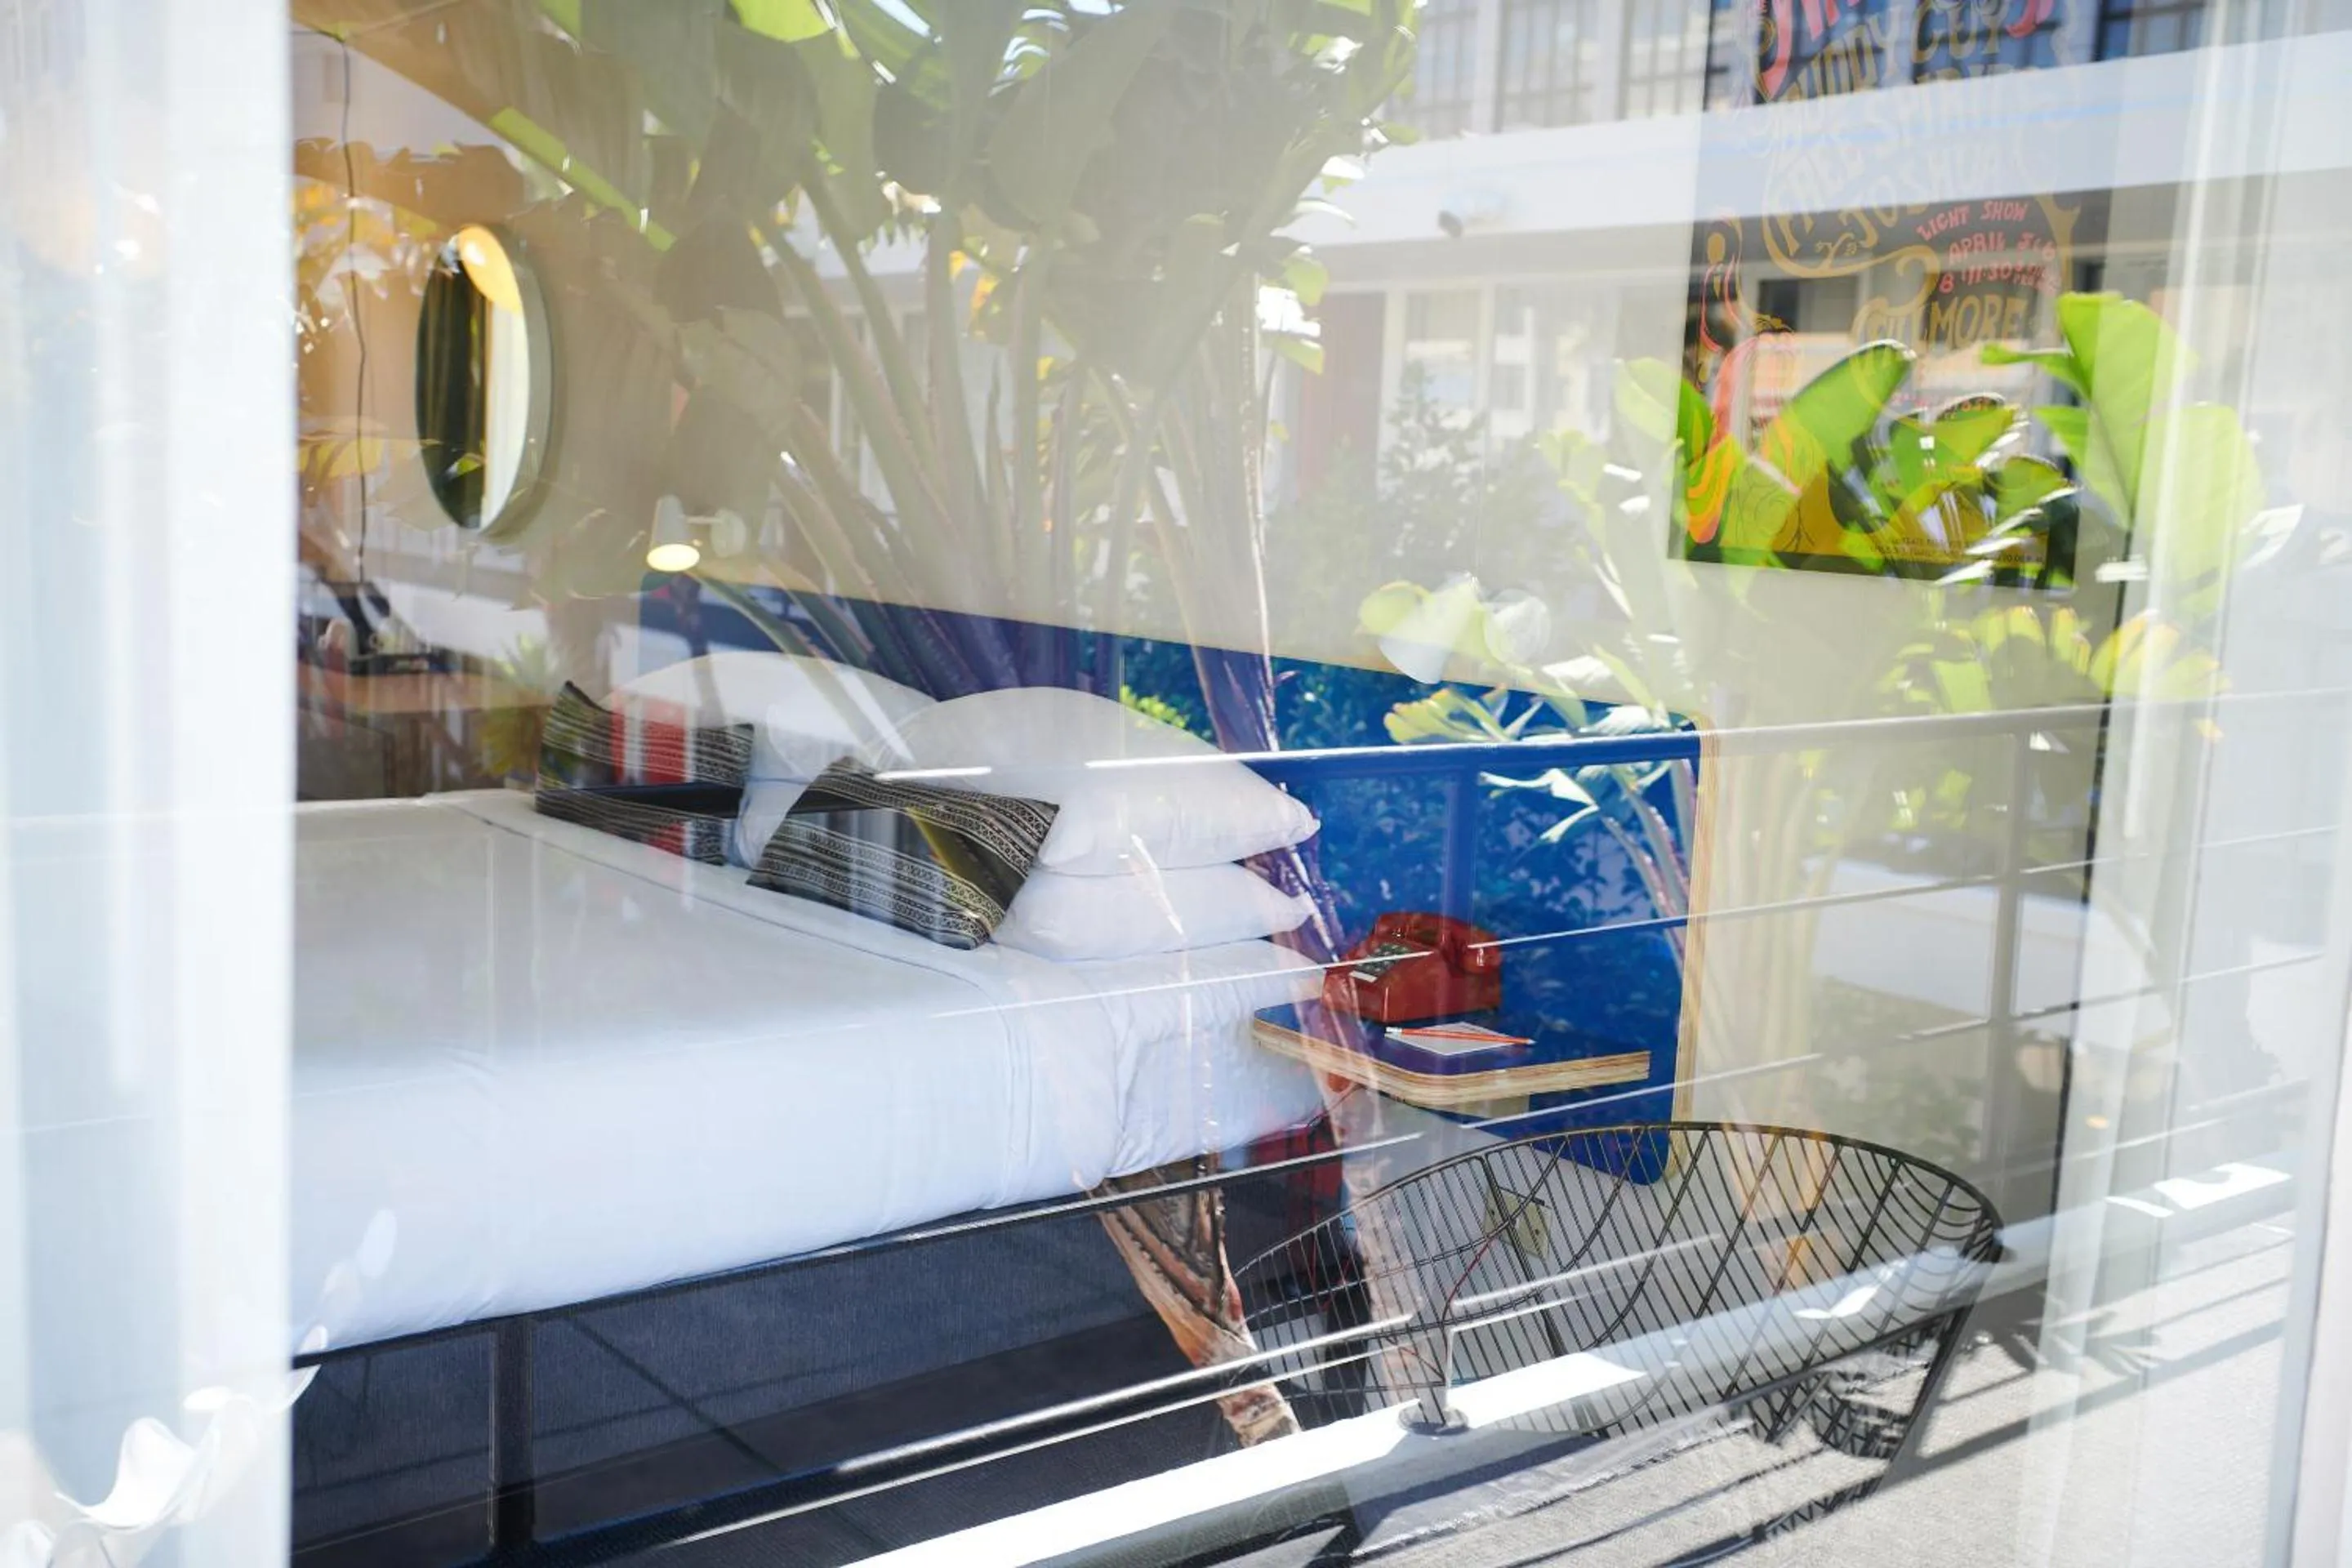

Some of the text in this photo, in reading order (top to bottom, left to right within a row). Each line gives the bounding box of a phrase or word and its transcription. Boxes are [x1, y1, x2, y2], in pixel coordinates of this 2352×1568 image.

[1916, 200, 2027, 242] LIGHT SHOW
[1949, 232, 2005, 266] APRIL
